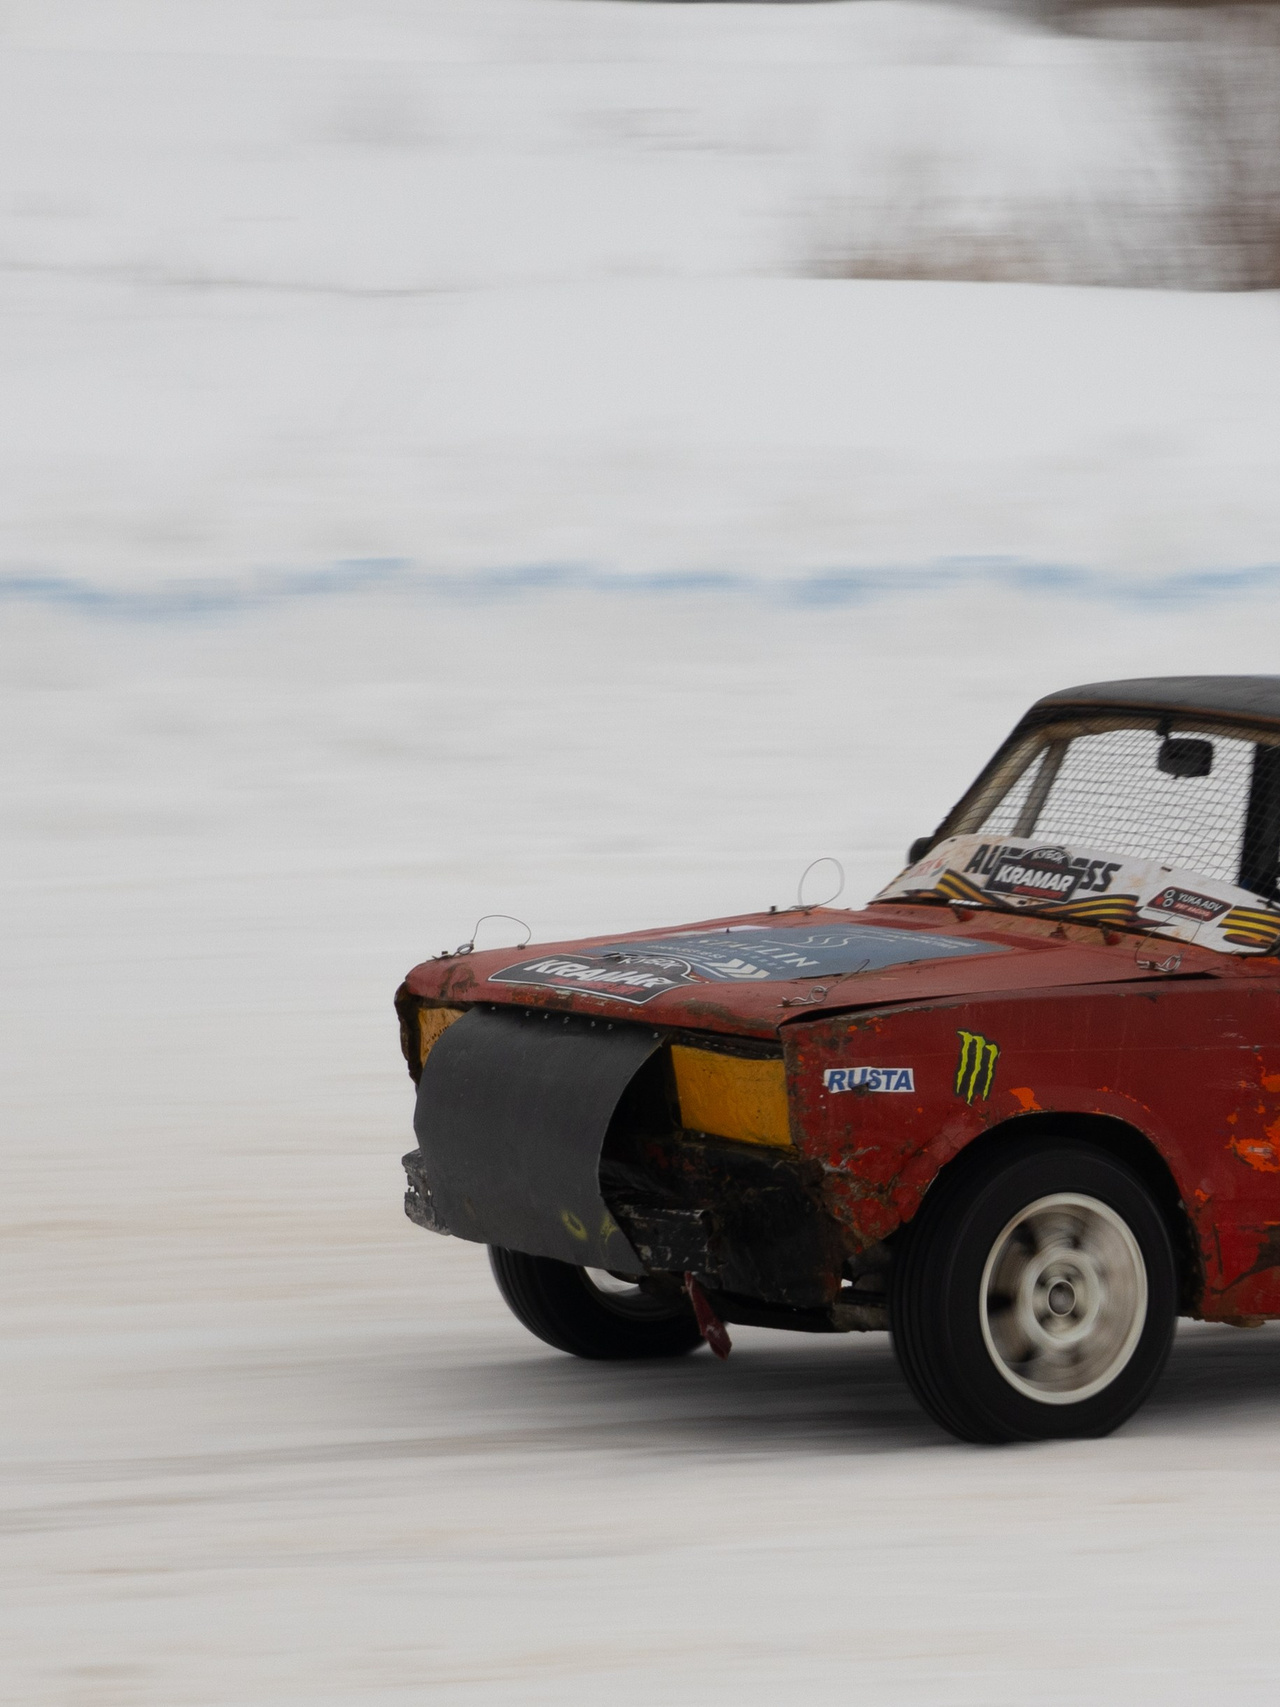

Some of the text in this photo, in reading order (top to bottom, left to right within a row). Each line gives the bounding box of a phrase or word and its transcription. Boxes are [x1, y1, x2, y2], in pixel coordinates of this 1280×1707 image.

[994, 864, 1075, 892] KRAMAR
[523, 960, 678, 987] KRAMAR
[828, 1069, 913, 1091] RUSTA
